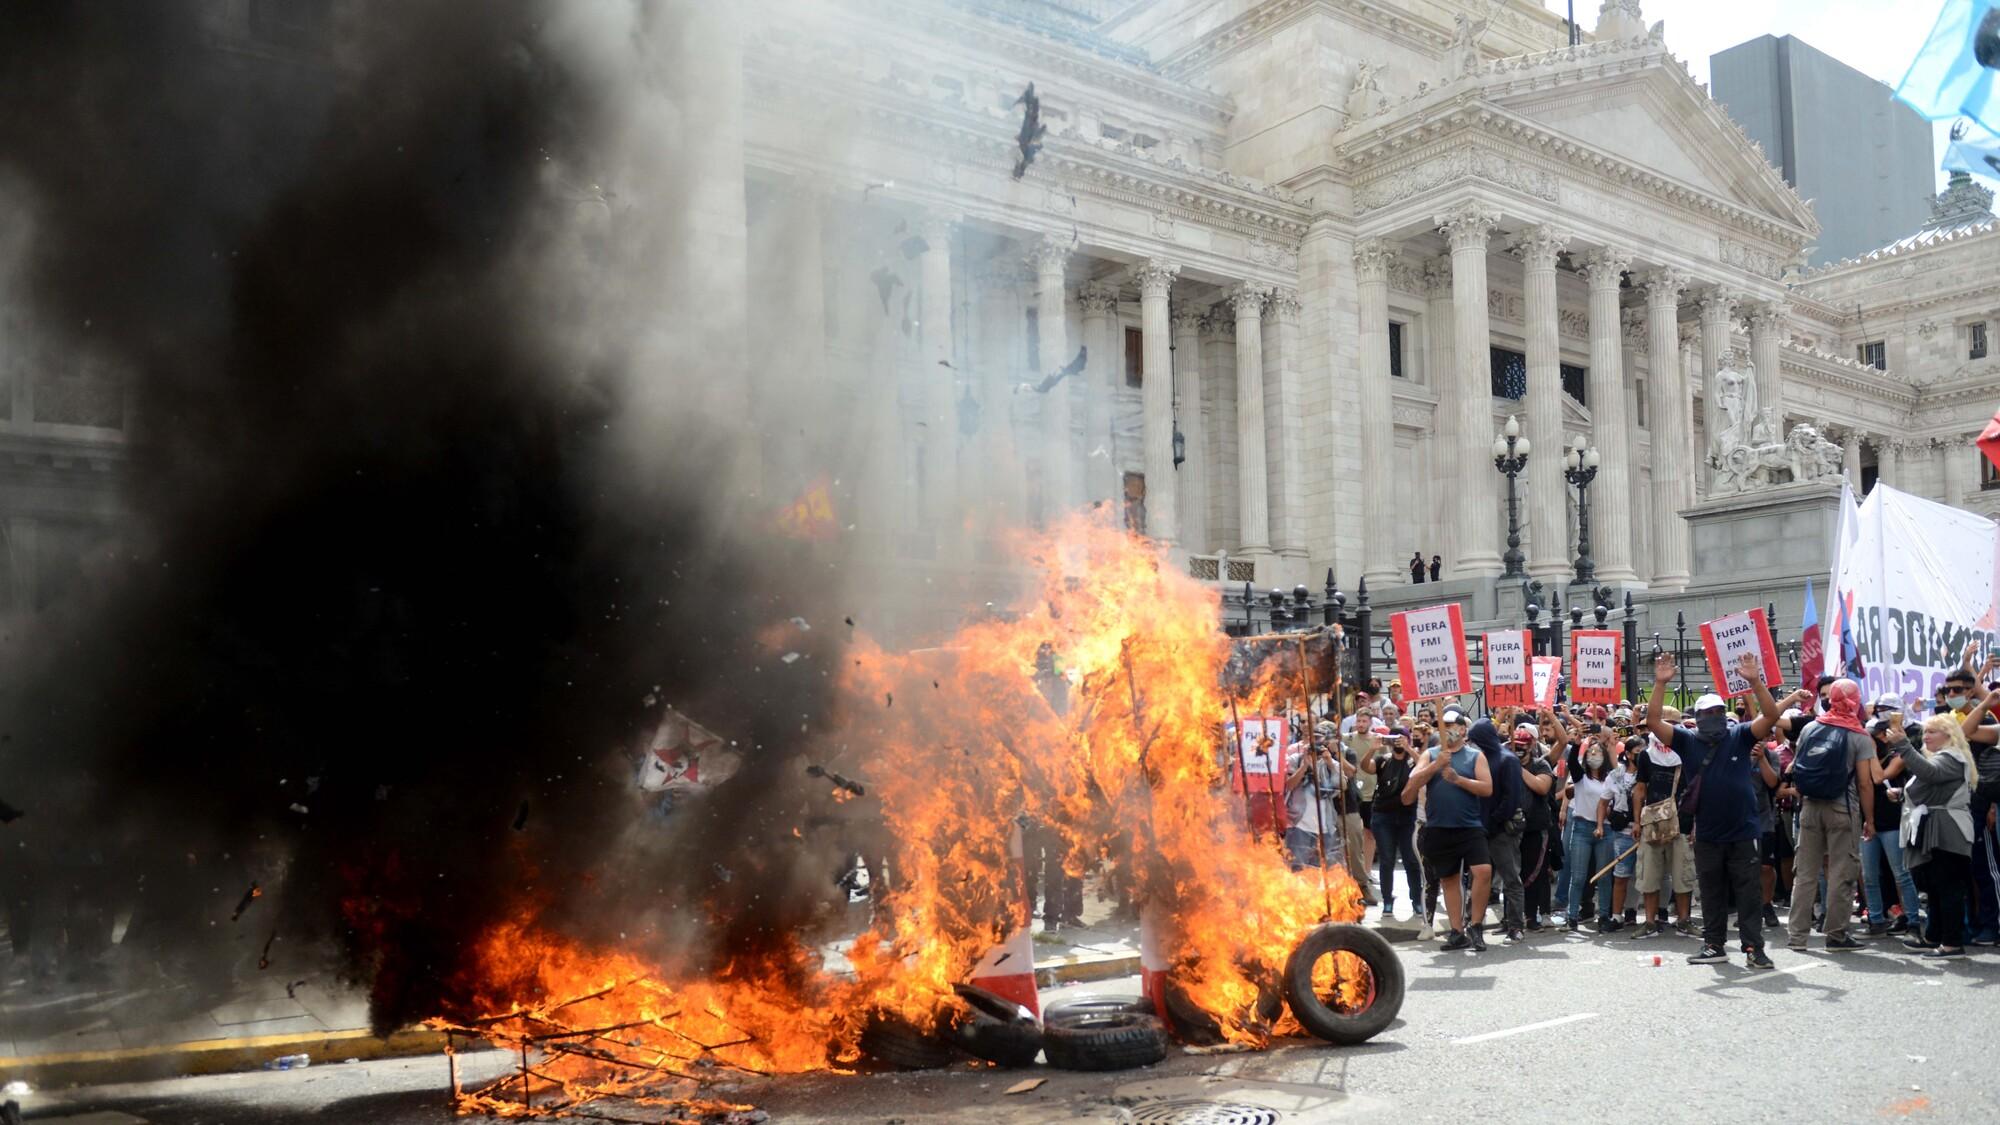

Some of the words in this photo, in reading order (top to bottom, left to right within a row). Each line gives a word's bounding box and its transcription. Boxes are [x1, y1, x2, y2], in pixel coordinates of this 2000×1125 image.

[1411, 620, 1447, 634] FUERA
[1716, 624, 1750, 640] FUERA
[1420, 636, 1441, 648] FMI
[1490, 642, 1521, 652] FUERA
[1727, 638, 1746, 651] FMI
[1580, 647, 1612, 656] FUERA
[1497, 656, 1515, 665] FMI
[1586, 660, 1605, 669] FMI
[1416, 666, 1456, 680] PRML
